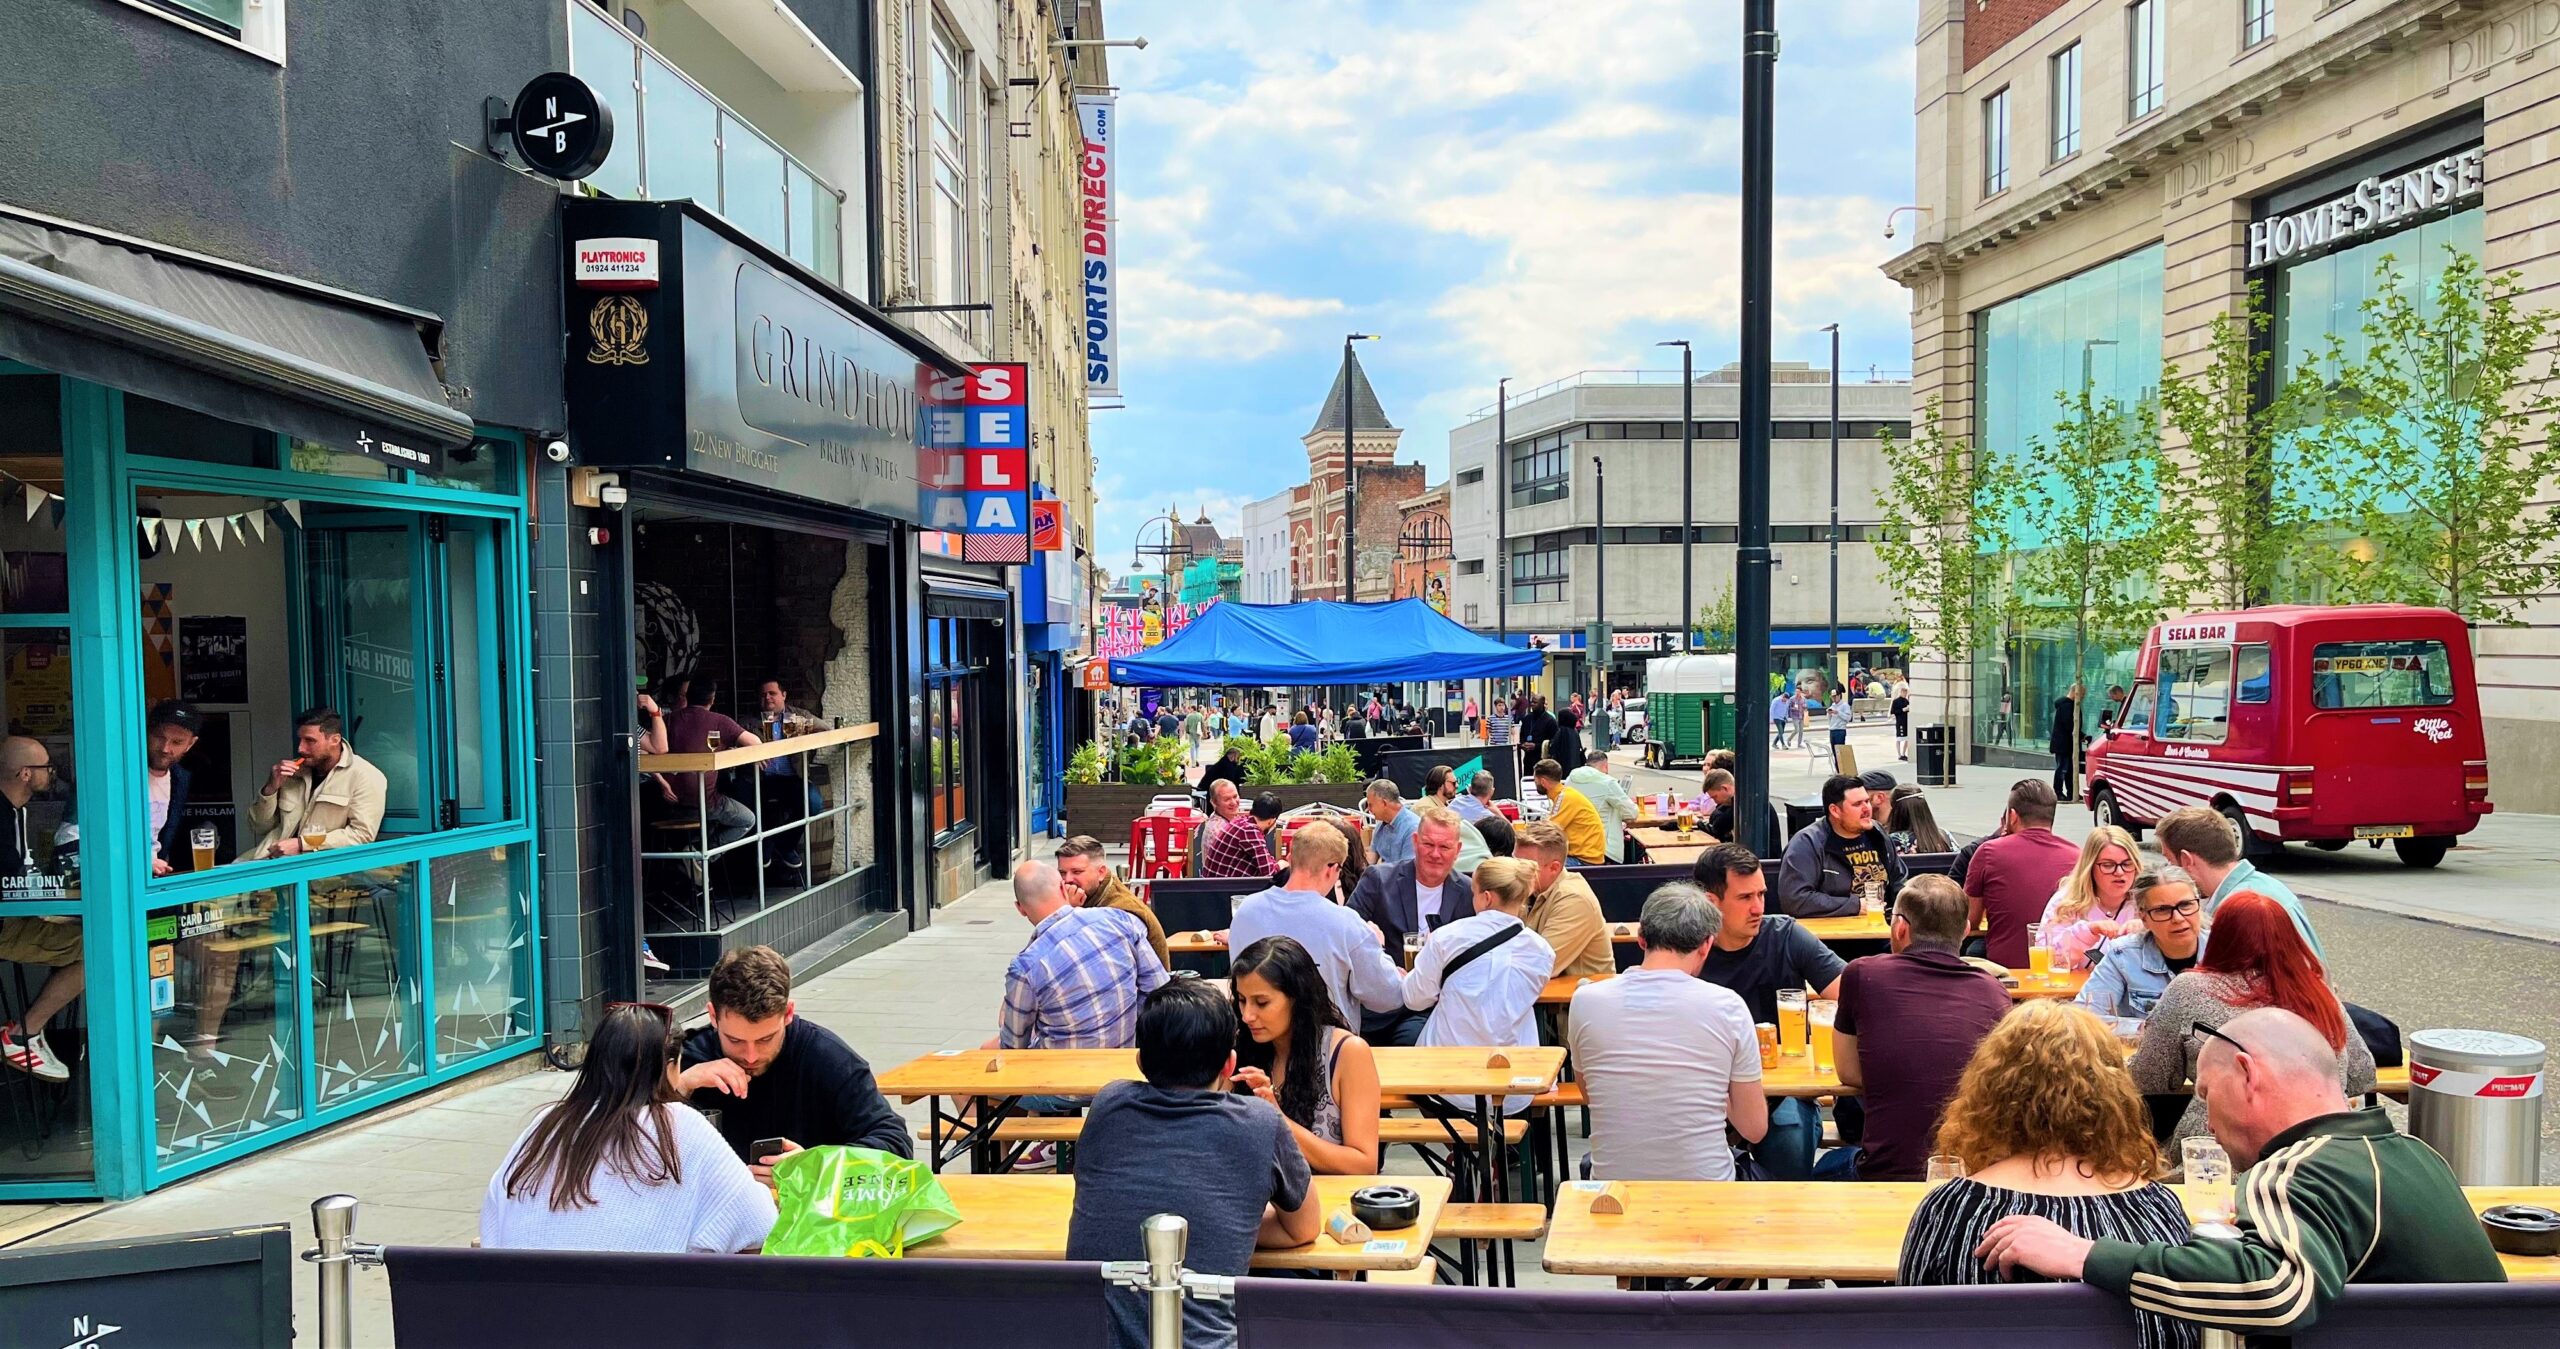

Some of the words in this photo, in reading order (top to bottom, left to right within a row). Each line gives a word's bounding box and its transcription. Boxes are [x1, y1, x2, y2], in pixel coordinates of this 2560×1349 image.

[545, 96, 557, 120] N
[555, 130, 567, 154] B
[581, 251, 646, 263] PLAYTRONICS
[586, 264, 609, 273] 01924
[611, 264, 640, 273] 411234
[1085, 259, 1108, 385] SPORTS
[752, 313, 938, 453] GRINDHOUSE
[693, 429, 706, 453] 22
[735, 442, 779, 473] BRIGGATE
[975, 368, 1018, 528] SELA
[820, 438, 855, 468] BREWS
[874, 456, 899, 483] BITES
[2168, 628, 2196, 641] SELA
[2200, 626, 2226, 640] BAR
[2413, 718, 2449, 734] Little
[2427, 727, 2454, 744] Red
[194, 808, 235, 816] HASLAM
[2, 876, 31, 888] CARD
[37, 875, 65, 887] ONLY
[181, 912, 202, 927] CARD
[204, 908, 224, 922] ONLY
[73, 1314, 89, 1338] N
